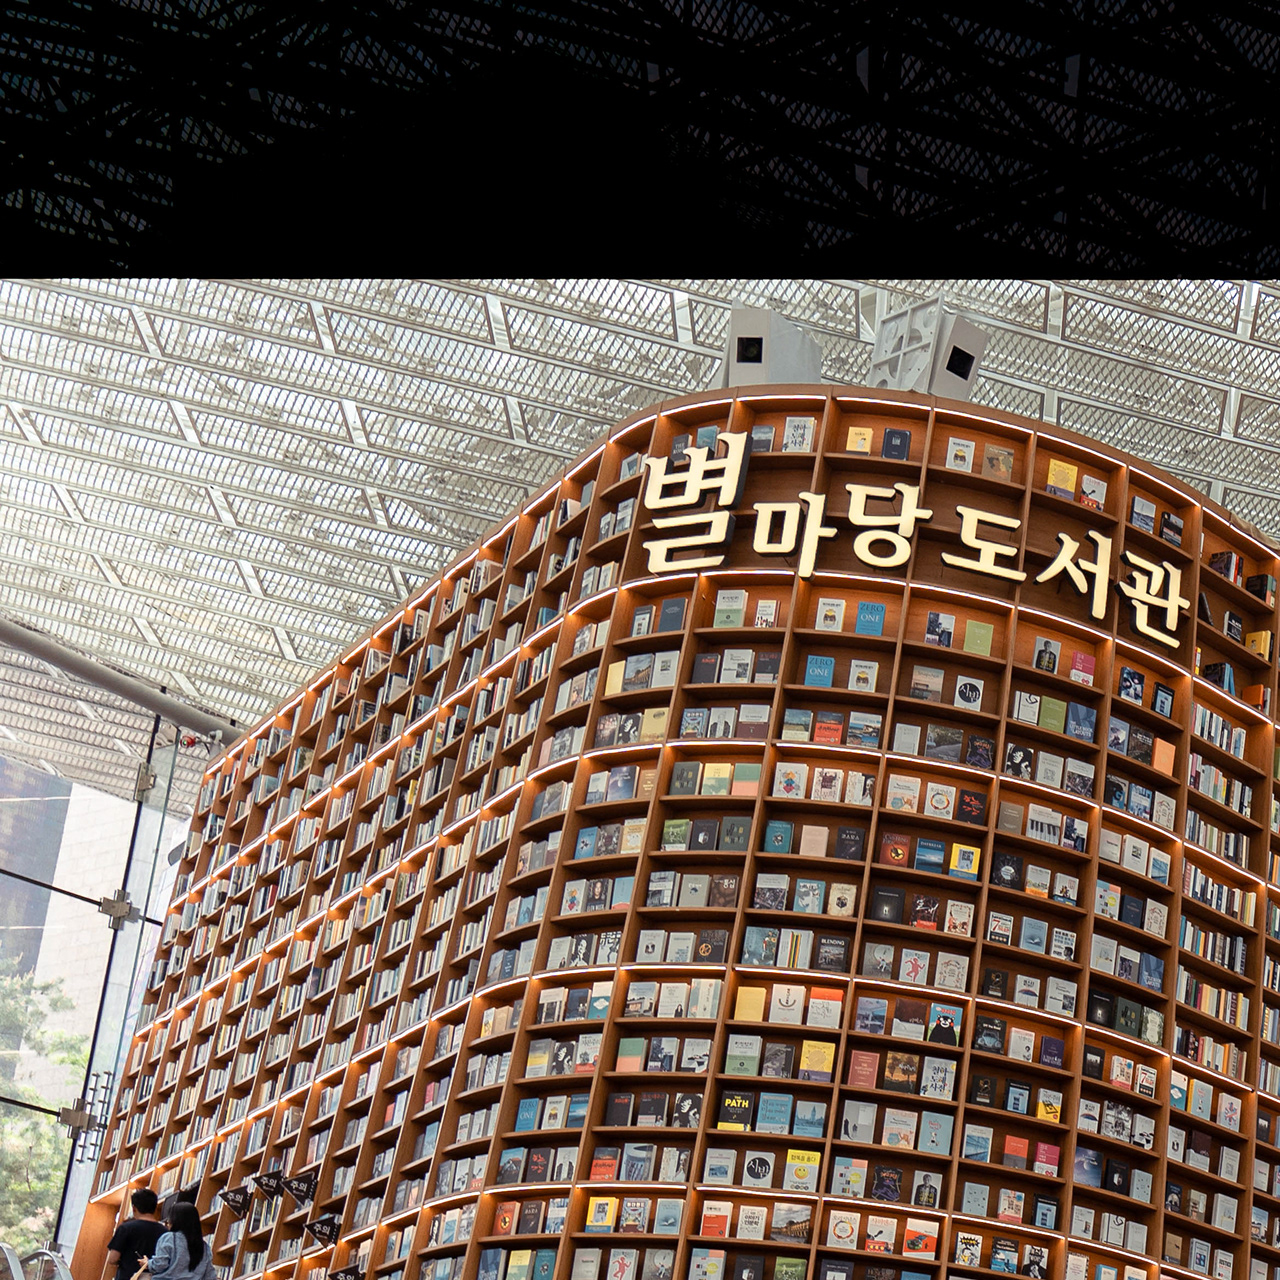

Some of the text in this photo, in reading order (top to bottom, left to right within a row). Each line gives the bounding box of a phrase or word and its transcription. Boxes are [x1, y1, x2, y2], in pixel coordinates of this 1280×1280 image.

[724, 1098, 750, 1109] PATH
[261, 1176, 277, 1187] 주의
[291, 1180, 307, 1190] 주의
[227, 1191, 243, 1201] 주의
[314, 1223, 330, 1234] 주의
